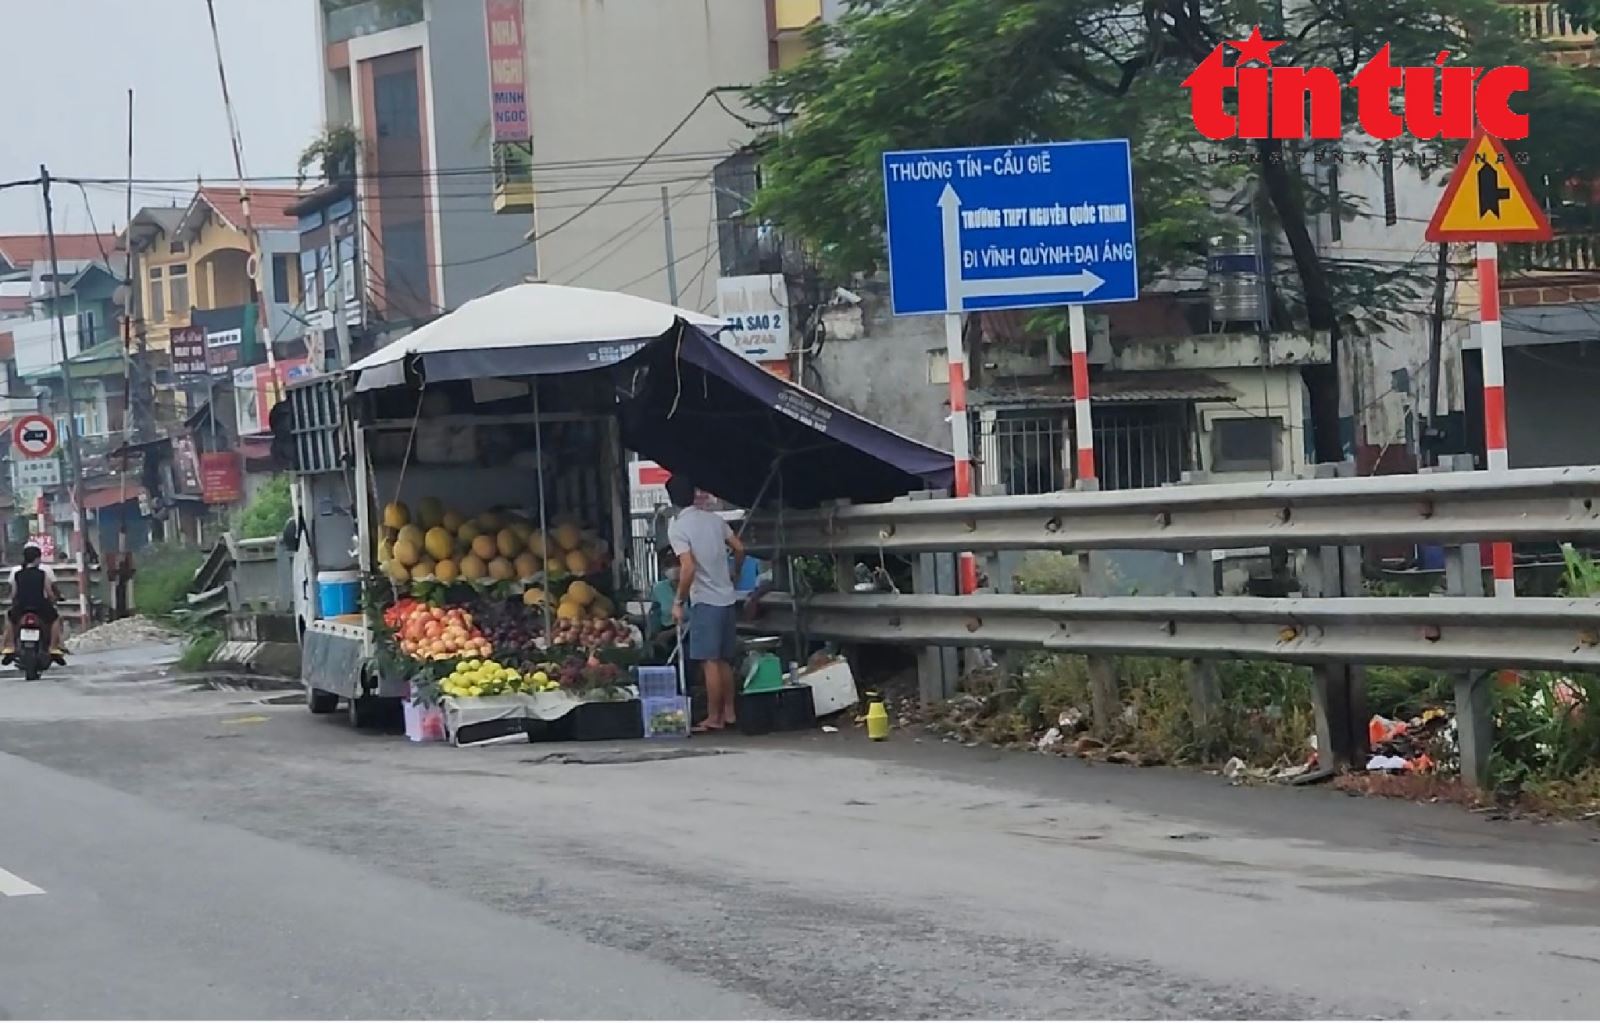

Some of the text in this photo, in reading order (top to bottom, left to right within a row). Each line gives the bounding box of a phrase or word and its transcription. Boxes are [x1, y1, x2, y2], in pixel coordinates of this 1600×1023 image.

[494, 91, 525, 104] MINH
[1002, 207, 1028, 228] THPT
[963, 250, 979, 269] ĐI
[981, 244, 1016, 268] VĨNH
[1103, 238, 1133, 262] ÁNG
[747, 315, 770, 331] SAO
[773, 314, 782, 330] 2
